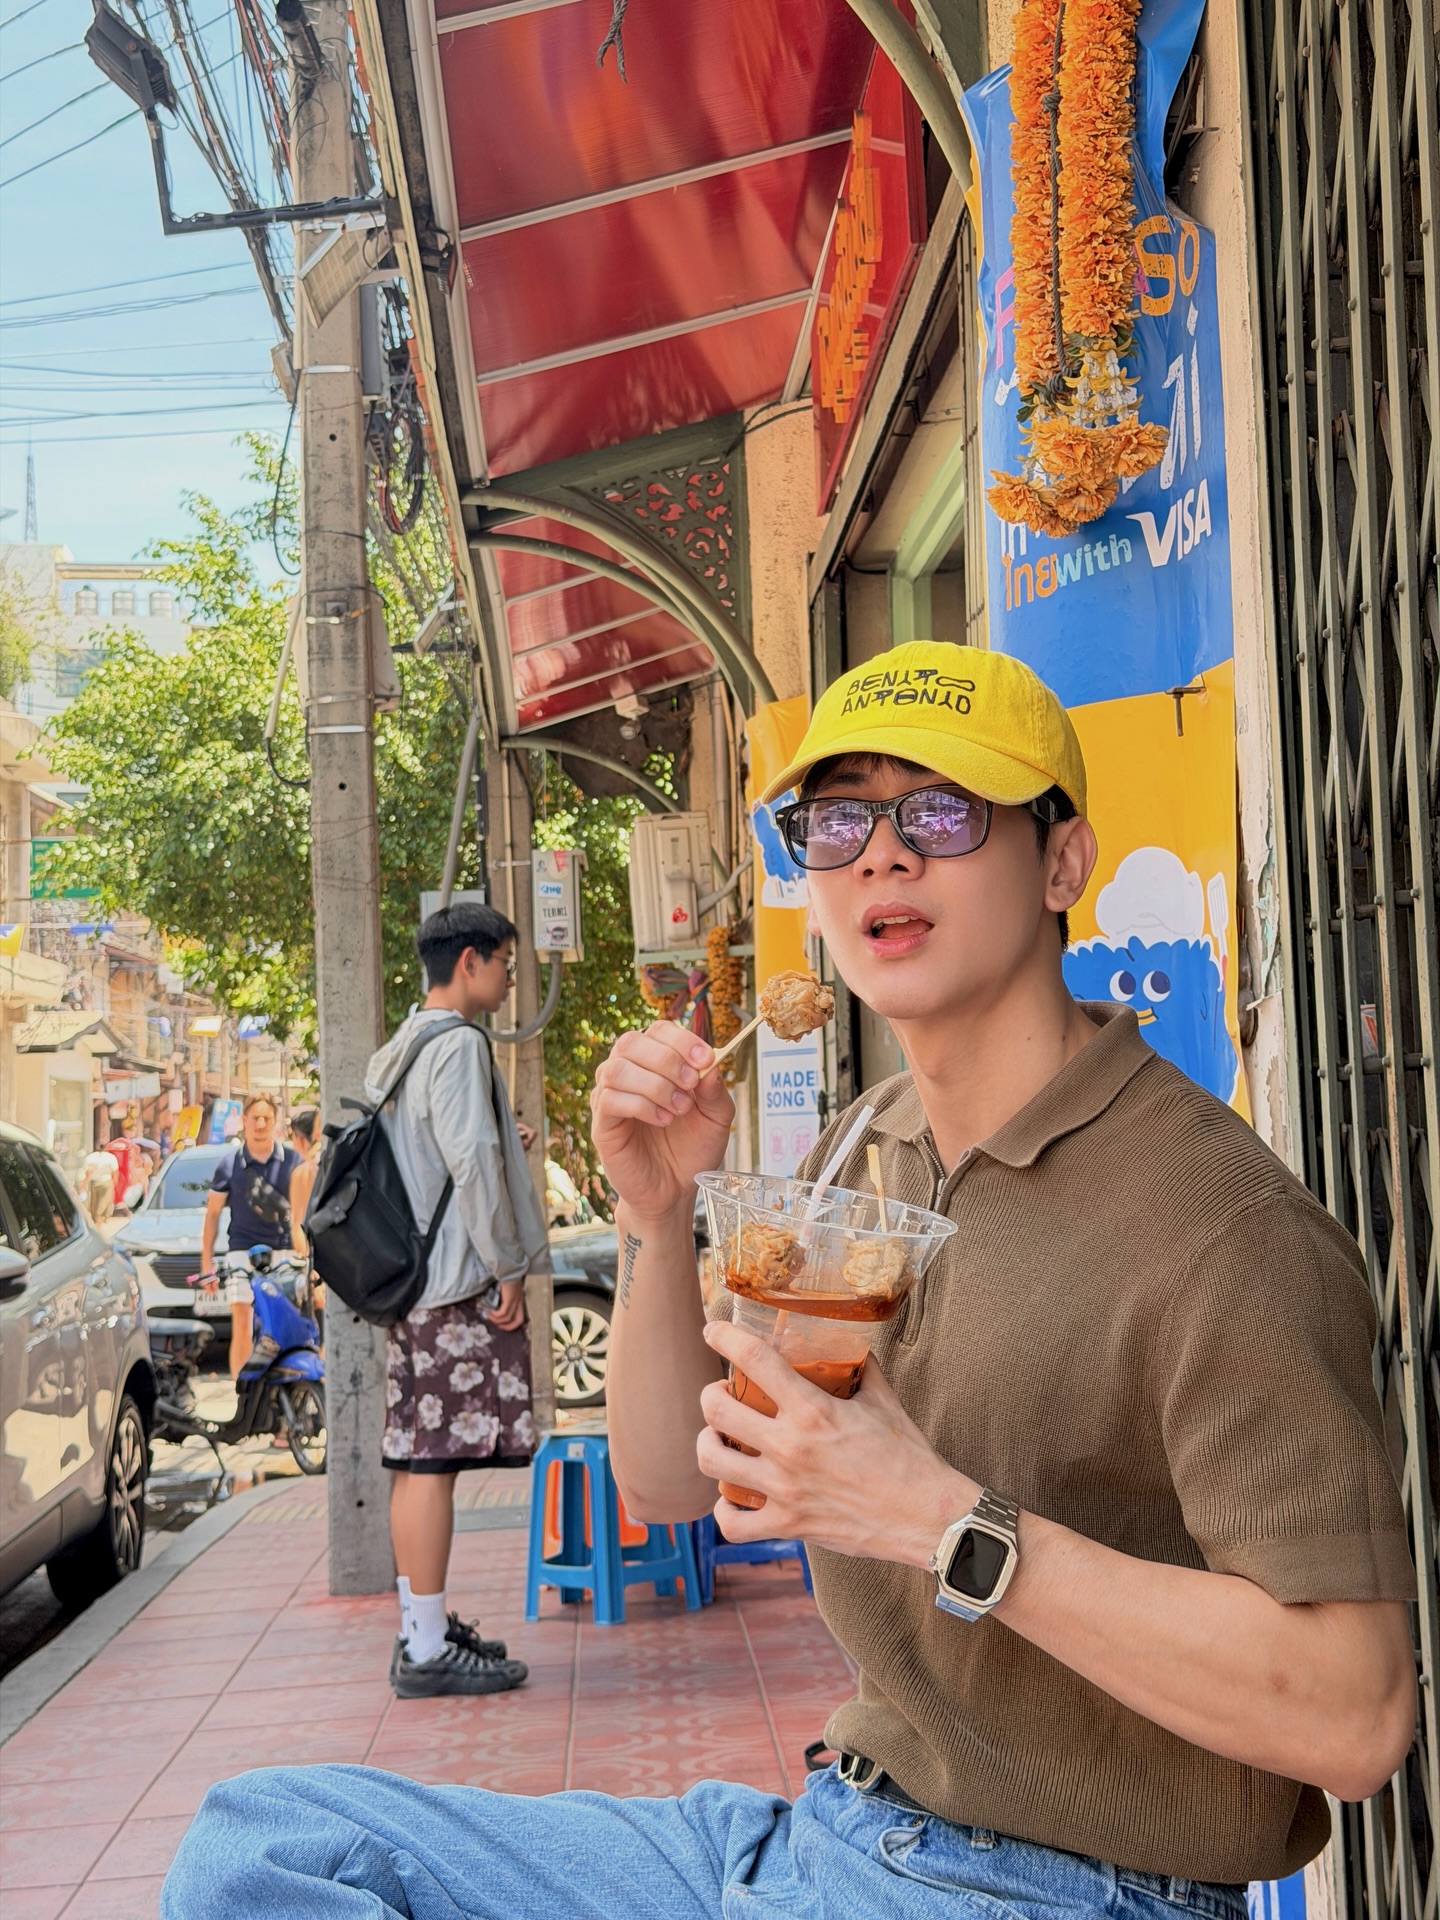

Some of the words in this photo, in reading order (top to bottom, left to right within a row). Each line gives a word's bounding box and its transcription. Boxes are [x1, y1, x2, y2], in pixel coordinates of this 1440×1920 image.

[1125, 478, 1212, 568] VISA
[840, 688, 971, 716] ANTONIO
[770, 1070, 815, 1089] MADE
[766, 1090, 805, 1109] SONG
